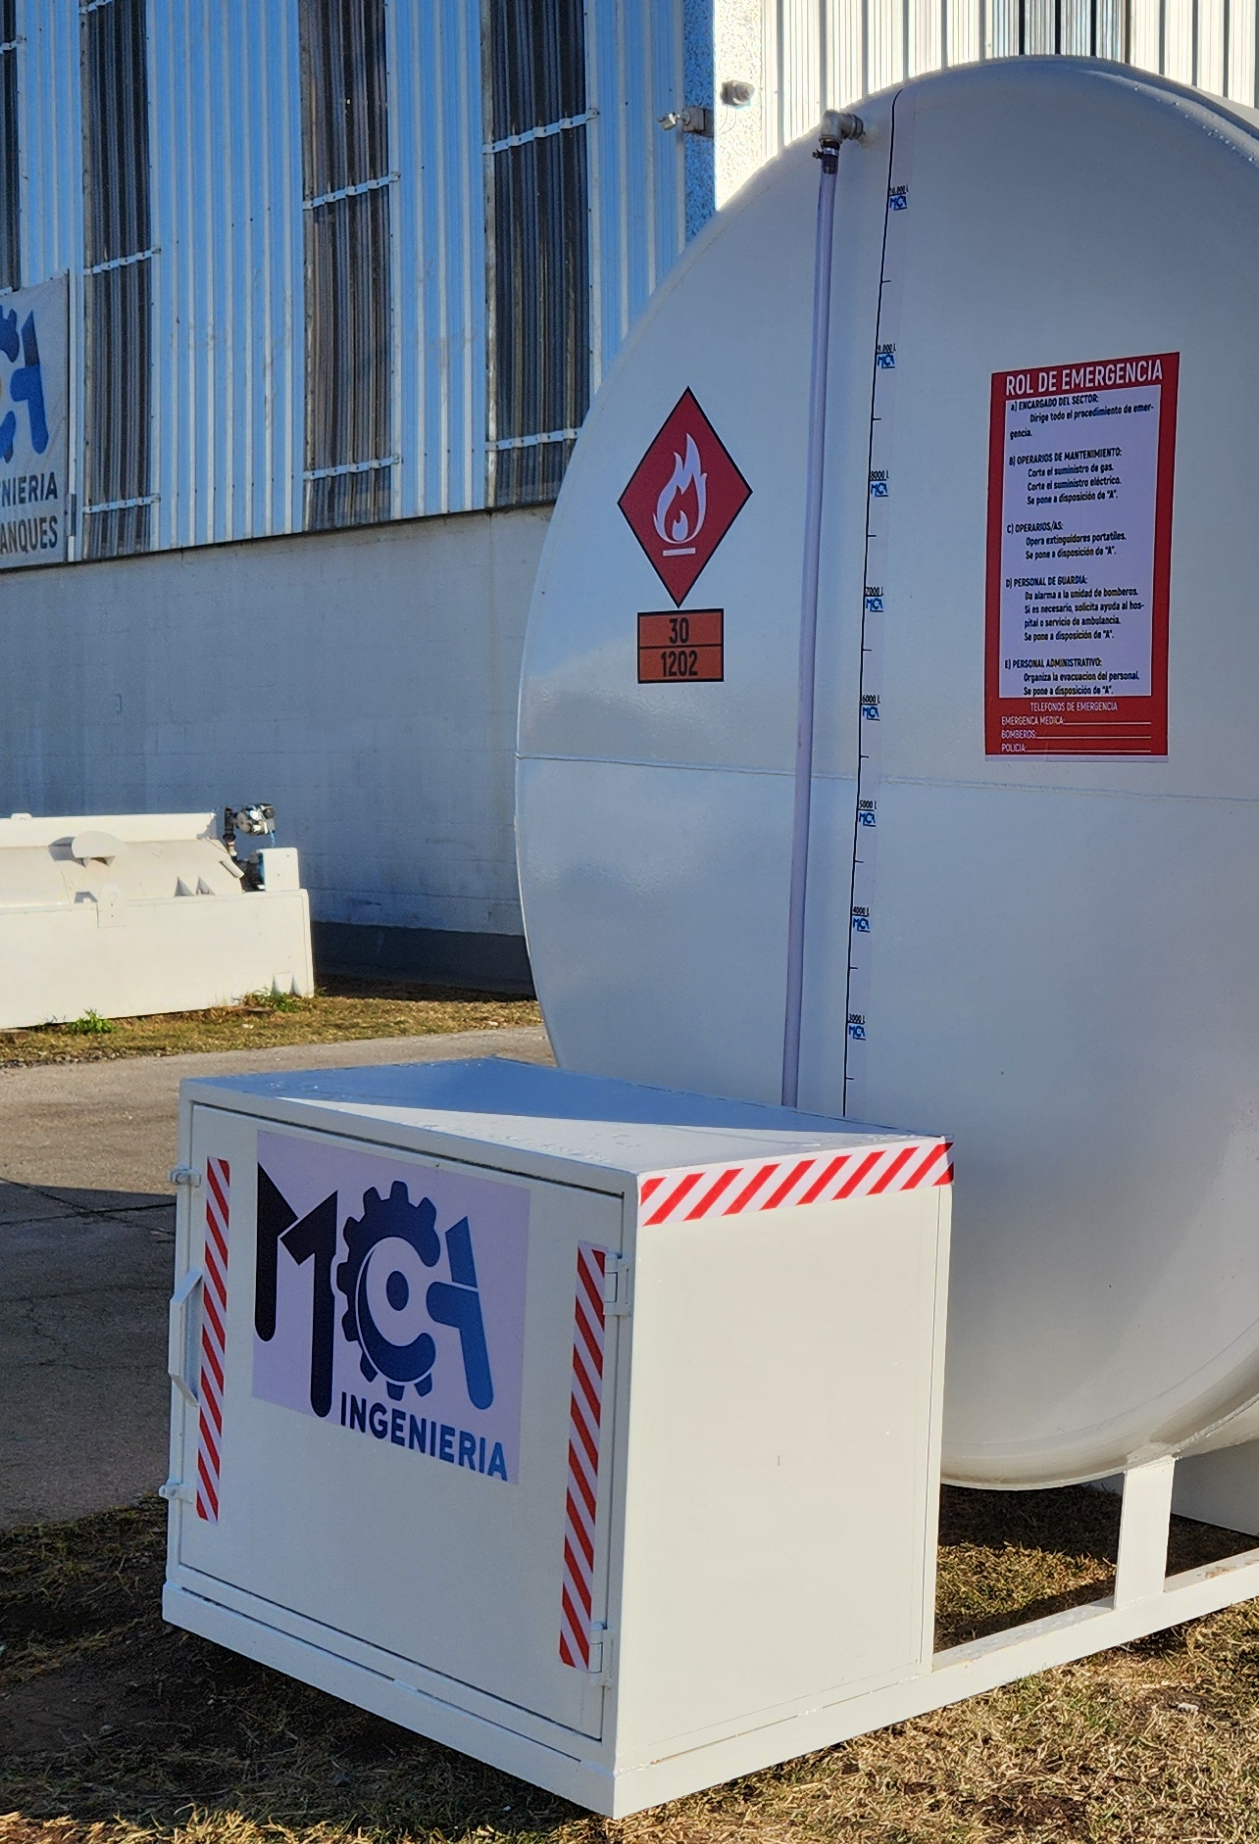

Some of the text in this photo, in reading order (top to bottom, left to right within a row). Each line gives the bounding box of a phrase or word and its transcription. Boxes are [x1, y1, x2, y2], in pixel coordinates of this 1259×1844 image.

[1006, 359, 1163, 396] ROL DE EMERGENCIA
[1019, 397, 1057, 410] ENCARGADO
[1059, 396, 1070, 406] DEL
[1072, 394, 1099, 405] SECTOR:
[1030, 404, 1154, 423] Dirige todo el procedimiento de emer-
[1010, 428, 1032, 440] gencia.
[1009, 447, 1122, 465] B) OPERARIOS DE MANTENIMIENTO:
[1028, 463, 1114, 477] Corte el suministro de gas.
[1028, 481, 1045, 491] Corte
[1047, 480, 1052, 490] el
[1054, 478, 1088, 489] suministro
[1027, 496, 1034, 505] Se
[1036, 495, 1052, 506] pone
[1059, 491, 1095, 503] disposición
[1097, 491, 1105, 500] de
[1007, 524, 1013, 534] C)
[1026, 537, 1044, 546] Opera
[1046, 533, 1090, 545] extinguidores
[1026, 550, 1033, 559] Se
[1035, 550, 1050, 560] pone
[1057, 547, 1094, 559] disposición
[1096, 546, 1103, 555] de
[1006, 575, 1087, 589] D) PERSONAL DE GUARDIA:
[1025, 587, 1138, 600] Da alarma a la unidad de bomberos.
[1025, 605, 1030, 614] Si
[1041, 604, 1073, 614] necesario,
[1075, 603, 1098, 612] solicita
[1100, 602, 1120, 613] ayuda
[1122, 601, 1127, 610] al
[1130, 601, 1144, 610] hos-
[1025, 619, 1038, 628] pital
[1045, 617, 1070, 626] servicio
[1072, 617, 1080, 626] de
[1082, 615, 1120, 625] ambulancia.
[669, 618, 689, 644] 30
[1024, 632, 1031, 641] Se
[1033, 633, 1048, 642] pone
[1056, 631, 1092, 640] disposición
[1094, 630, 1101, 638] de
[661, 650, 697, 677] 1202
[1005, 658, 1102, 669] E) PERSONAL ADMINISTRATIVO:
[1024, 673, 1051, 683] Organiza
[1053, 672, 1058, 681] la
[1098, 672, 1107, 680] del
[1109, 672, 1139, 681] personal.
[1024, 687, 1031, 696] Se
[1033, 687, 1048, 696] pone
[1055, 686, 1091, 696] disposición
[1093, 686, 1100, 695] de
[1030, 702, 1117, 711] TELEFONOS DE EMERGENCIA
[254, 1161, 494, 1418] MCA
[340, 1391, 508, 1481] INGENIERIA
